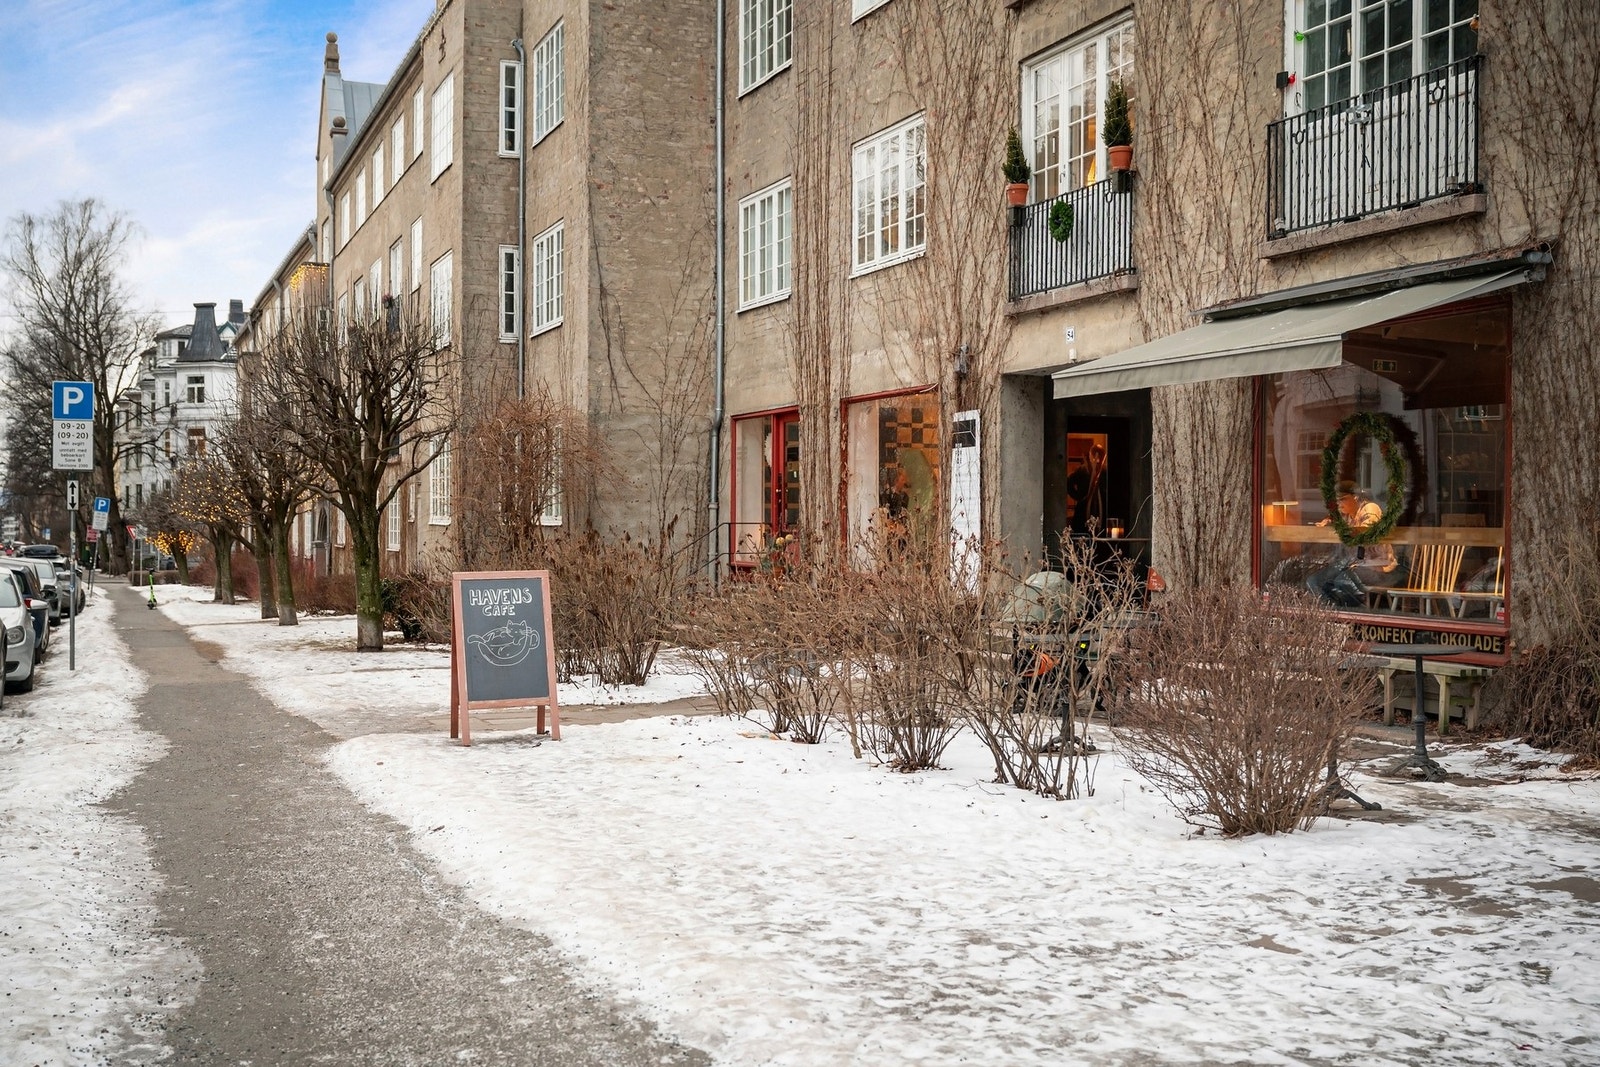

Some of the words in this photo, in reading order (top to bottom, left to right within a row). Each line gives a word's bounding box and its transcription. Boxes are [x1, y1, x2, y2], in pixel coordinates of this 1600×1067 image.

[63, 386, 84, 415] P
[98, 500, 106, 510] P
[469, 587, 533, 606] HAVENS
[482, 604, 516, 617] CAFE
